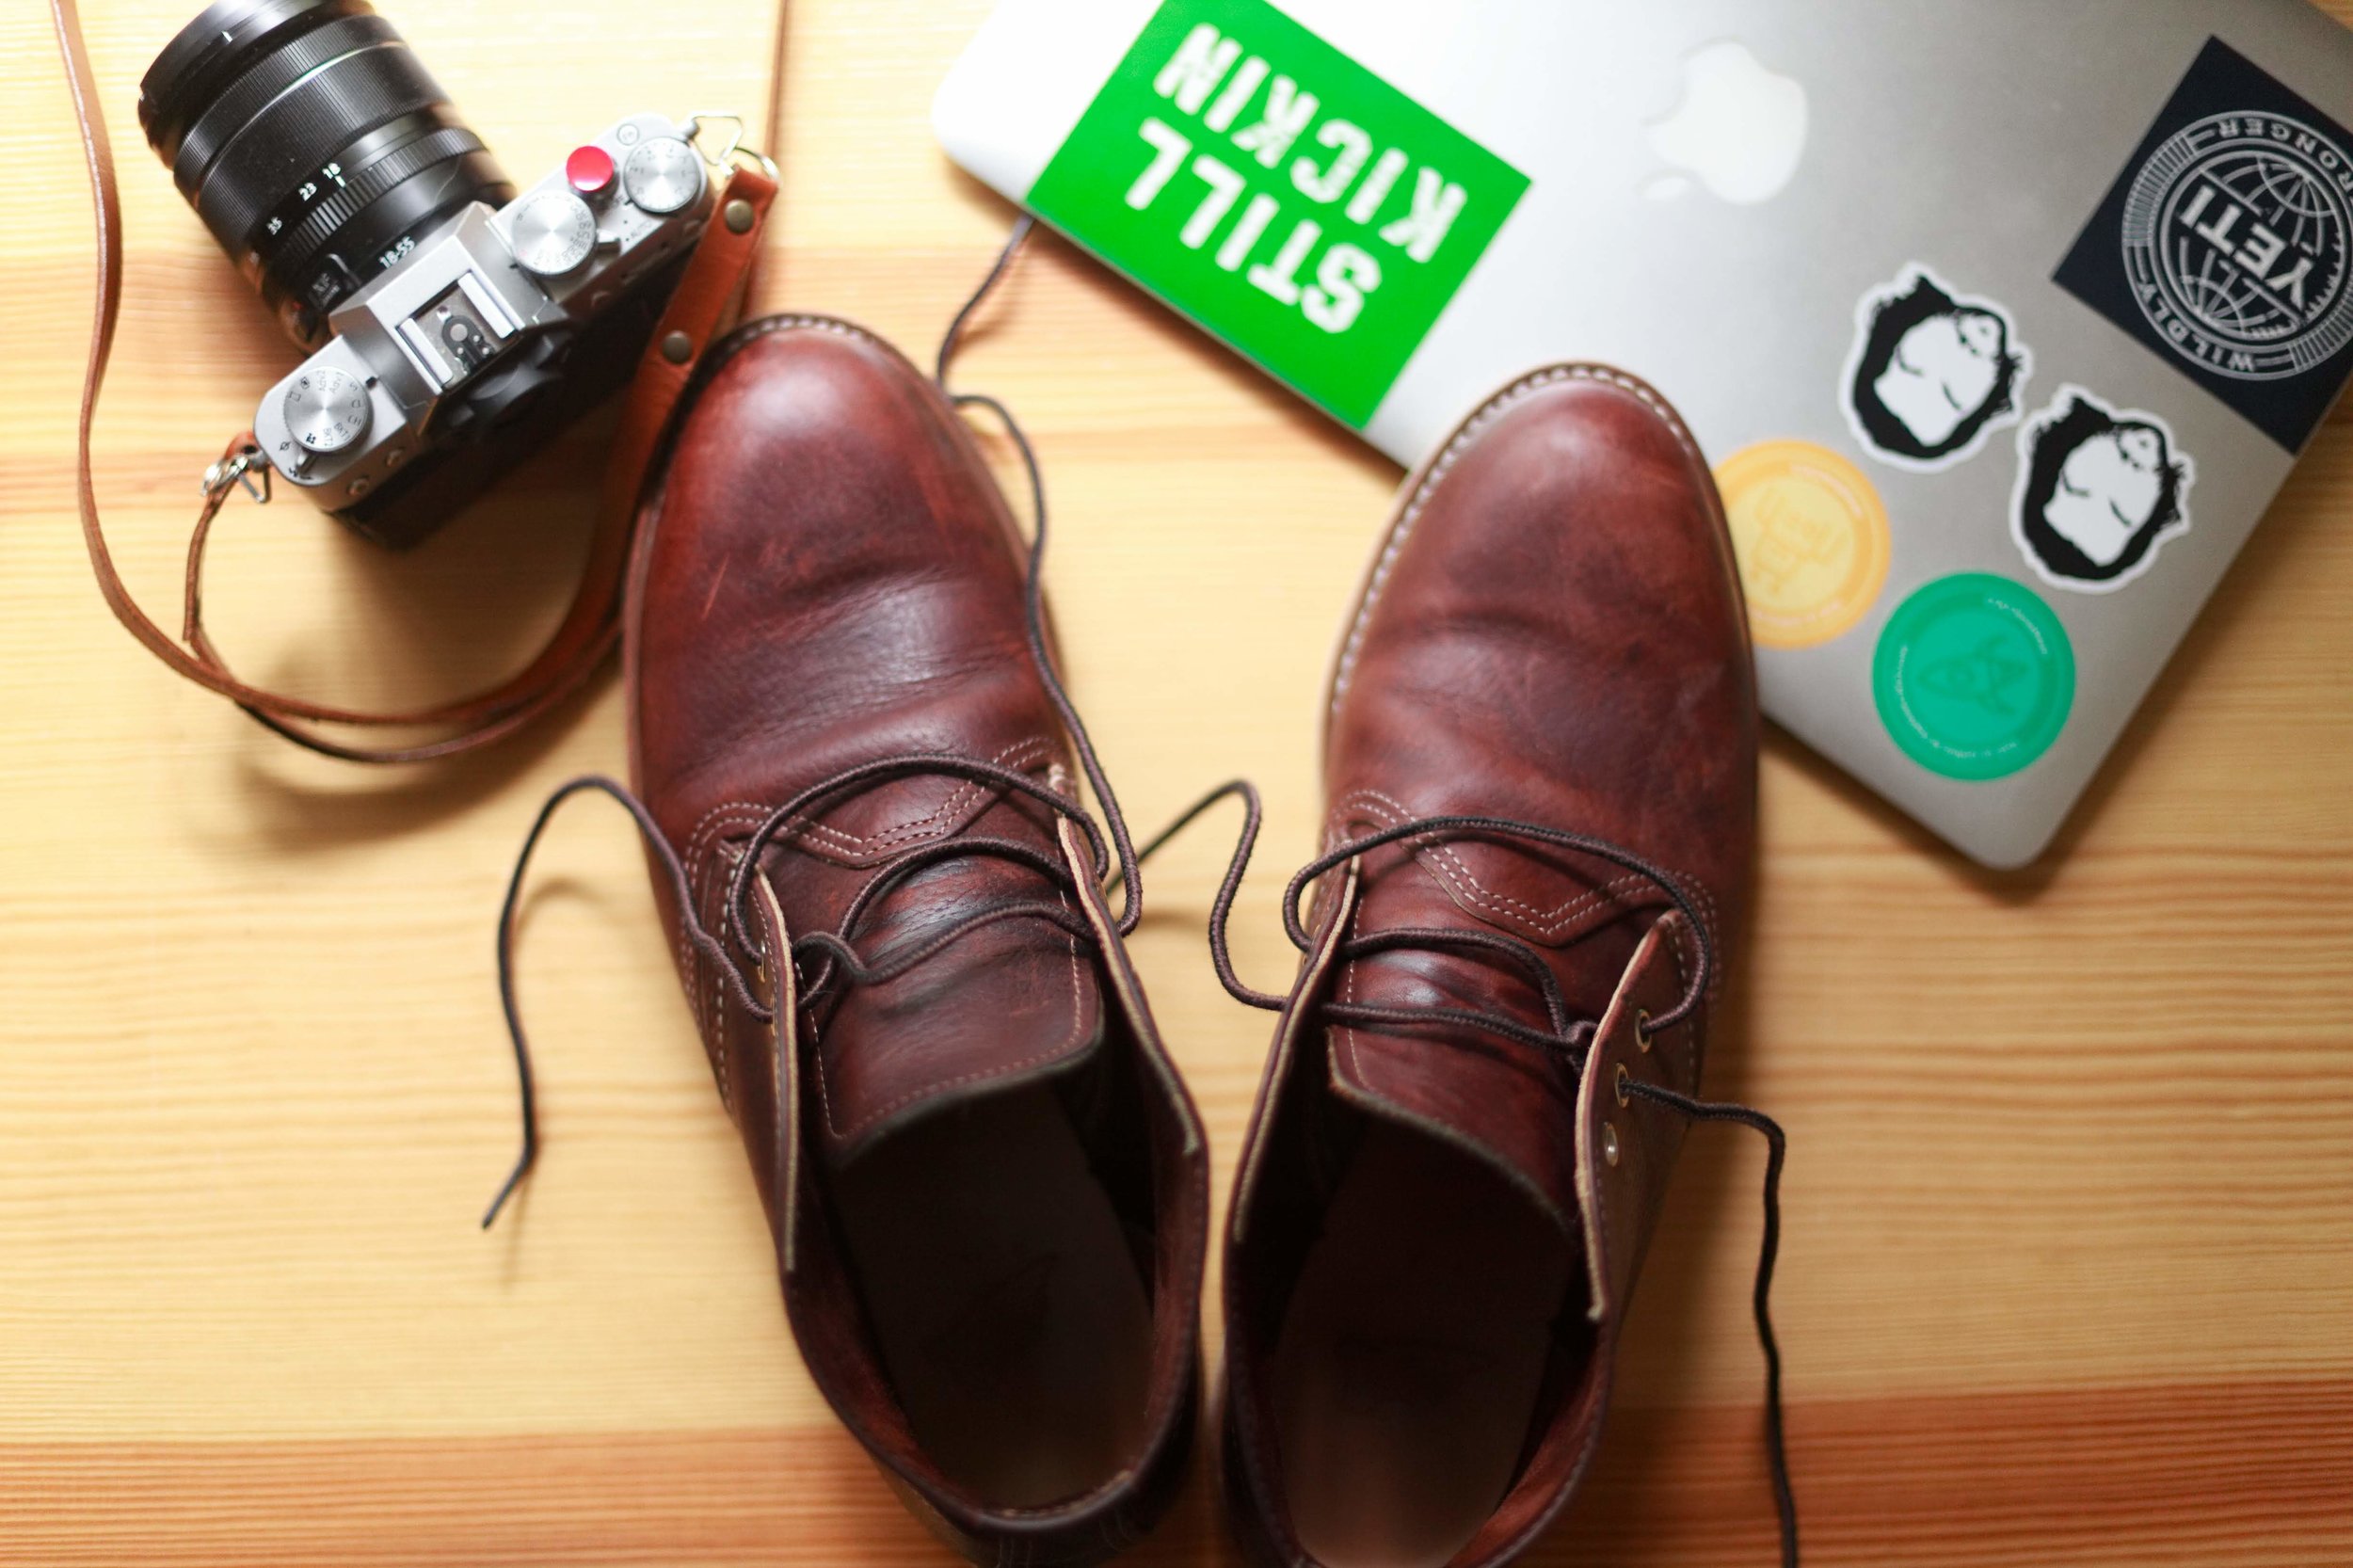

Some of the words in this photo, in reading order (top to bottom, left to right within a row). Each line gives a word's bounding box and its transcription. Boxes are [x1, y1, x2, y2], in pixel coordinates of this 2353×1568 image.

[298, 182, 318, 201] 23
[322, 162, 342, 180] 18
[1152, 22, 1468, 264] KICKIN
[2217, 118, 2353, 194] RONGER
[378, 235, 415, 269] 18-55
[1124, 116, 1383, 334] STILL
[2178, 184, 2315, 311] YETI
[2137, 281, 2257, 373] WILDLY
